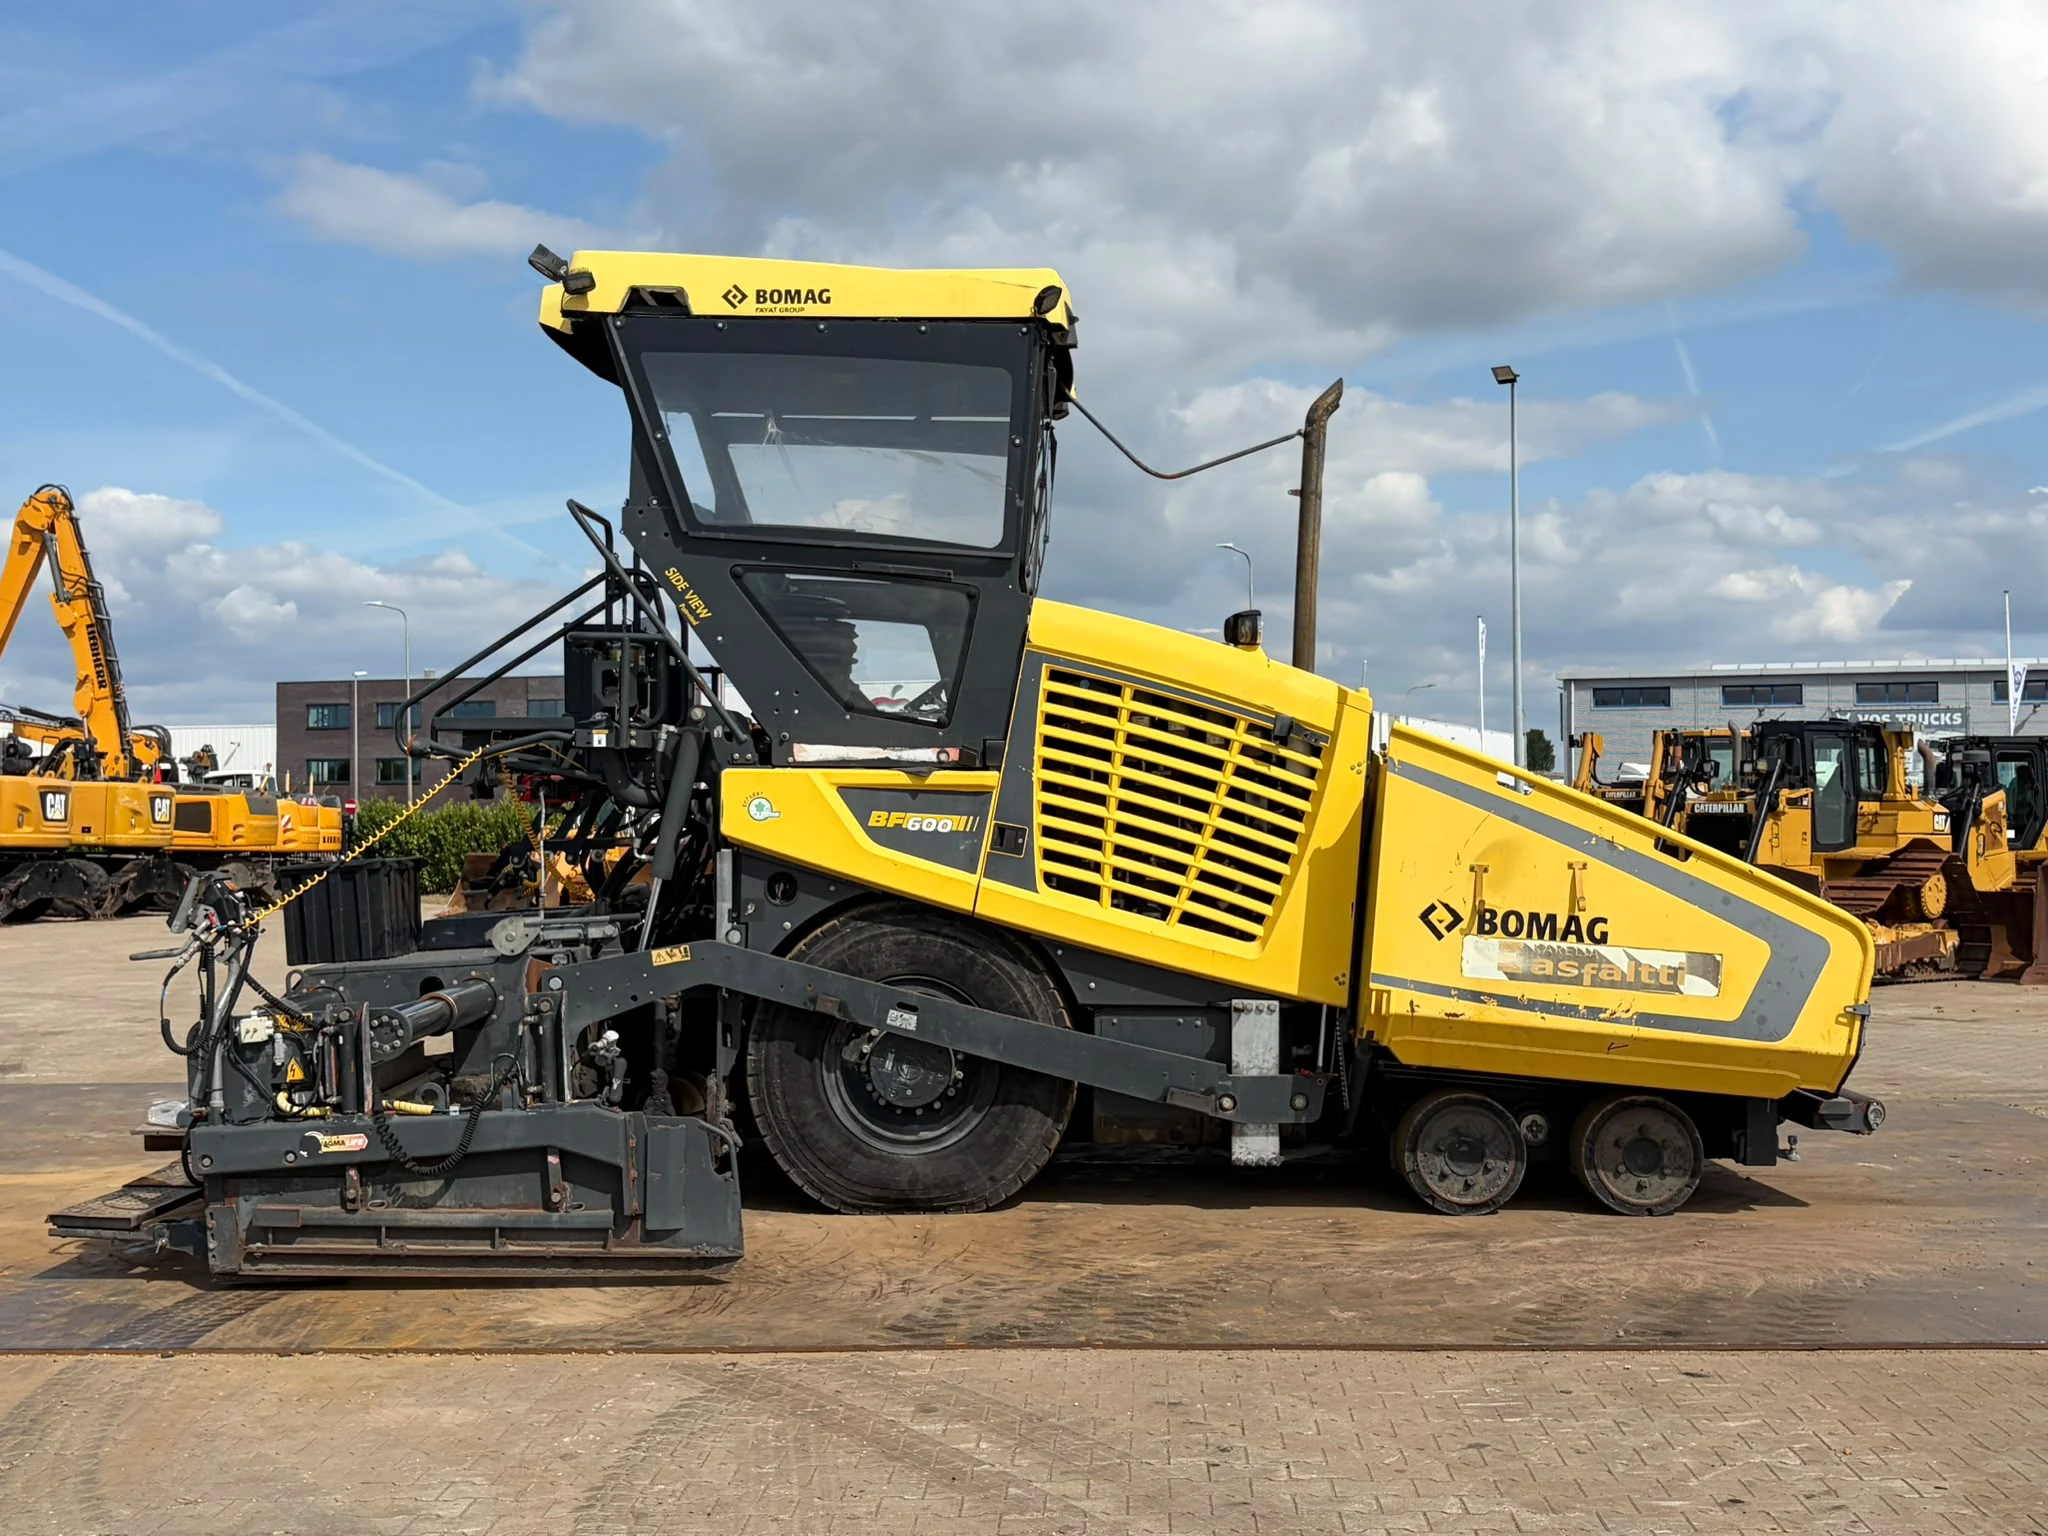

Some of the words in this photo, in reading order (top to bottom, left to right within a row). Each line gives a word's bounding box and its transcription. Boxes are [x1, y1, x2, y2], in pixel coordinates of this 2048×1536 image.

[755, 288, 831, 305] BOMAG
[665, 567, 690, 592] SIDE
[684, 589, 712, 618] VIEW
[86, 623, 107, 690] LIEBHERR
[1895, 712, 1962, 725] TRUCKS
[46, 793, 66, 820] CAT
[154, 798, 171, 822] CAT
[1694, 803, 1745, 814] CATERPILLAR
[1476, 908, 1609, 945] BOMAG
[1529, 957, 1687, 987] asfaltti
